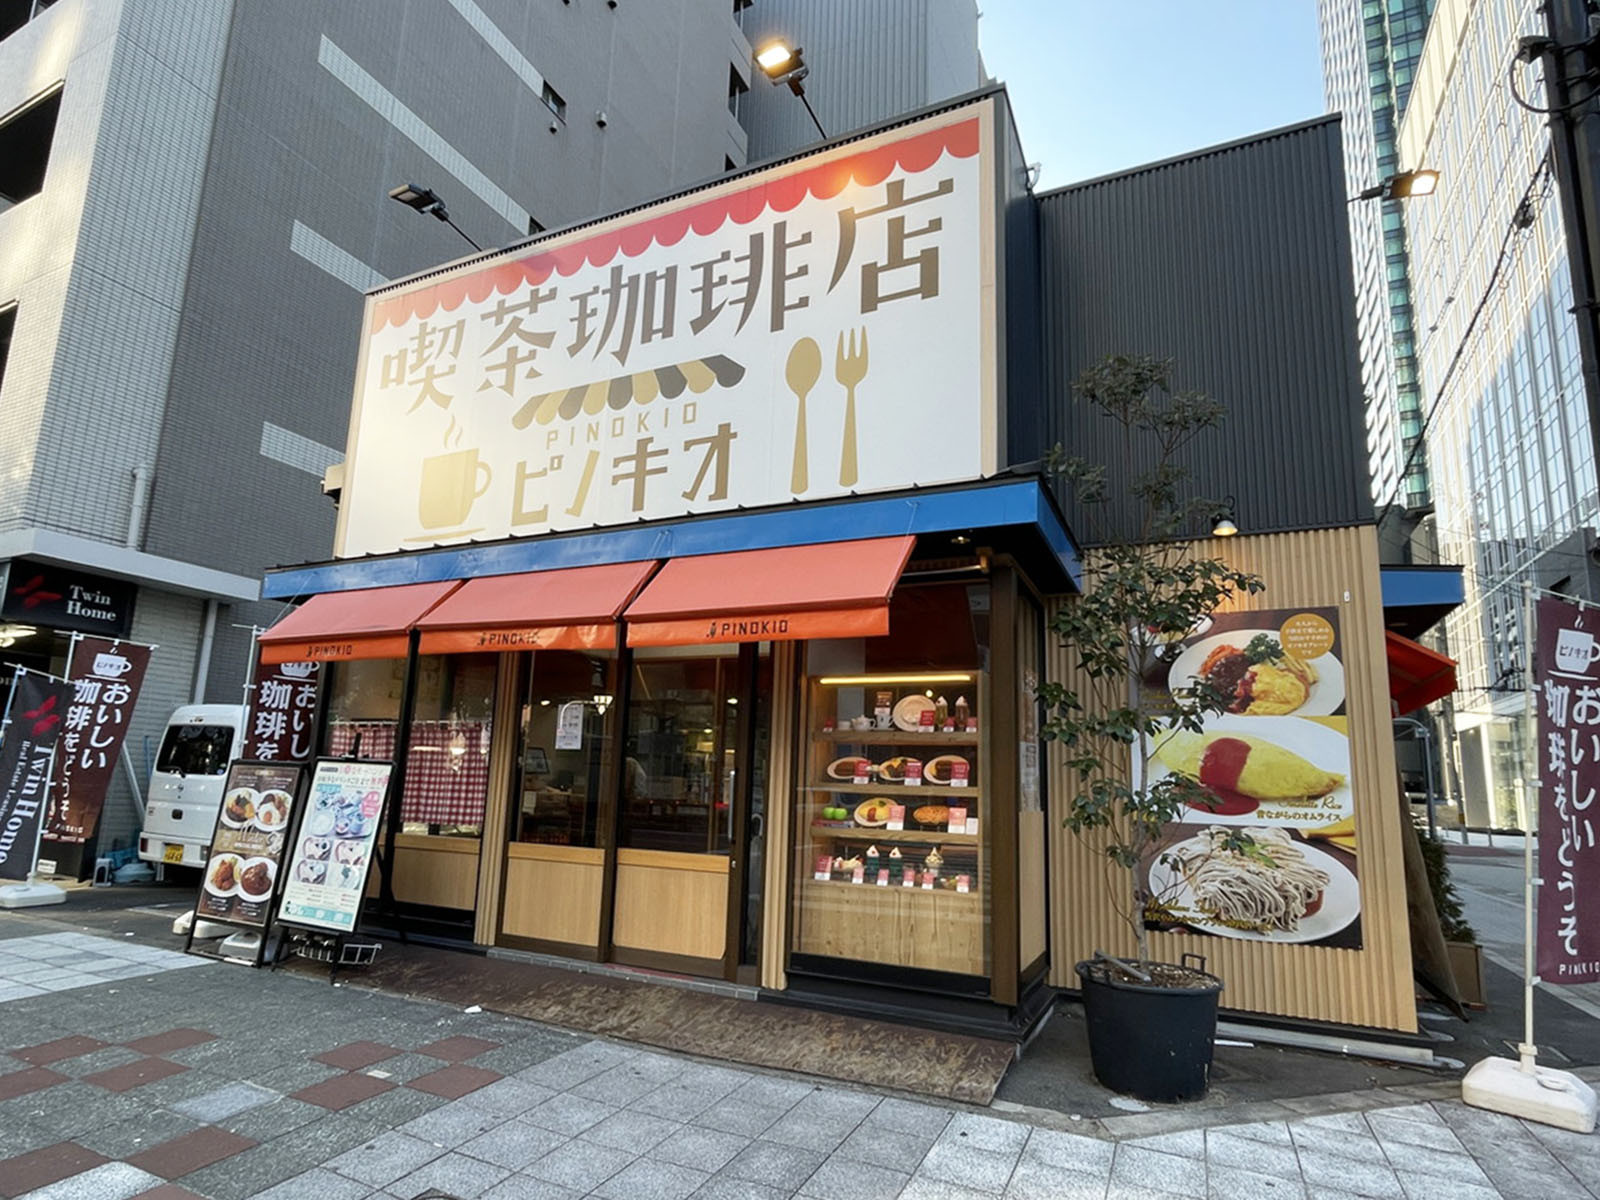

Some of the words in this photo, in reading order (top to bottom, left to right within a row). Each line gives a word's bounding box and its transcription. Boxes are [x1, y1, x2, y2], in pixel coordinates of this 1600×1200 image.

[379, 177, 954, 415] 喫茶珈琲店
[546, 402, 697, 450] PINOKIO
[511, 422, 738, 527] ピノキオ
[66, 600, 117, 621] Home
[69, 584, 111, 606] Twin
[314, 645, 353, 656] PINOKIO
[721, 619, 788, 636] PINOKIO
[80, 683, 132, 769] おいしい
[1571, 685, 1600, 852] おいしい
